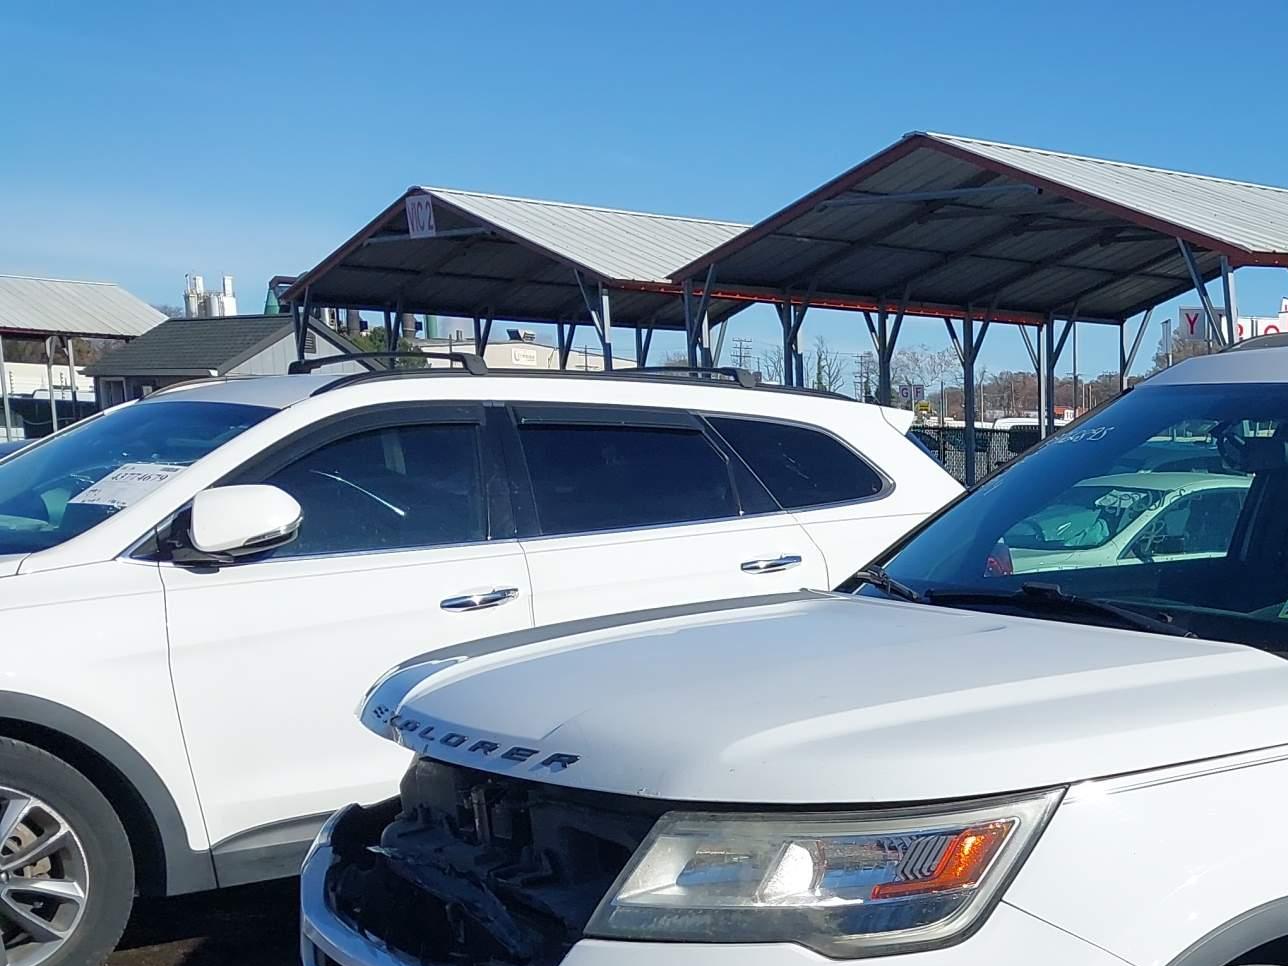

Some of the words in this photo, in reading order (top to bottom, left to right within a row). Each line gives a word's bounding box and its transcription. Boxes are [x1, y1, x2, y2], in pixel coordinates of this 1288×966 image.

[1185, 312, 1199, 335] Y
[901, 387, 909, 398] G
[915, 387, 922, 398] F
